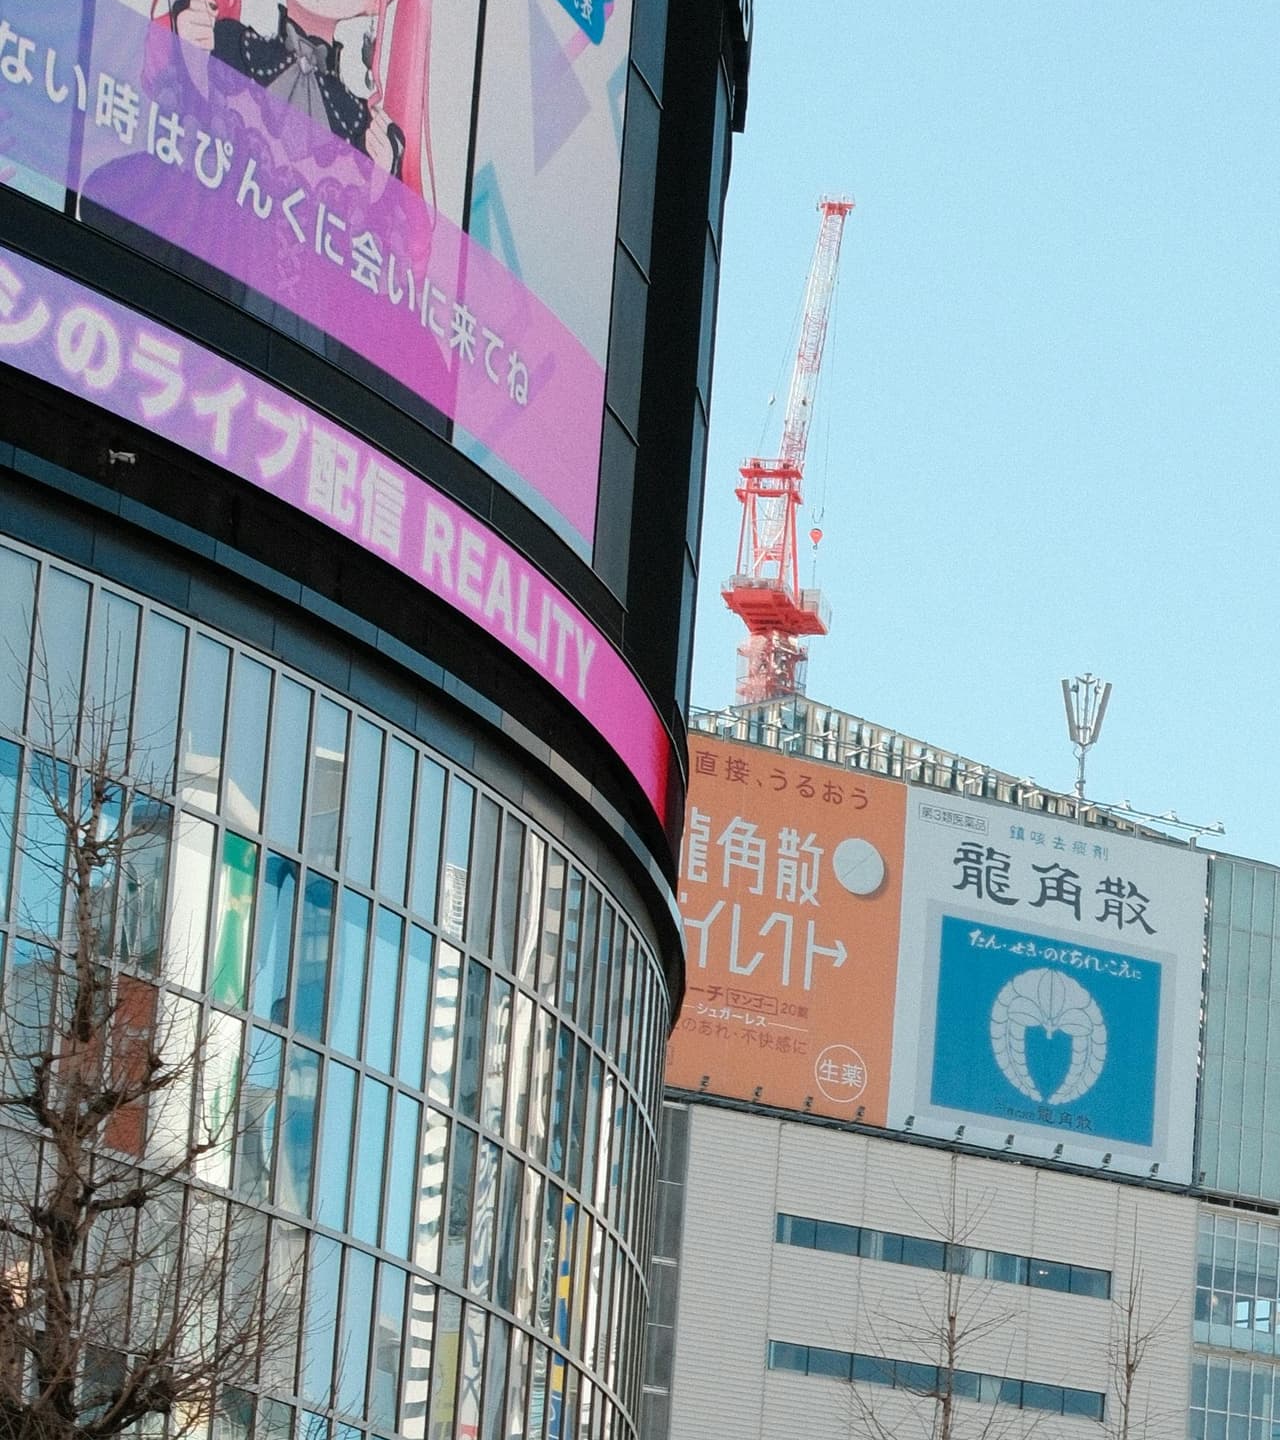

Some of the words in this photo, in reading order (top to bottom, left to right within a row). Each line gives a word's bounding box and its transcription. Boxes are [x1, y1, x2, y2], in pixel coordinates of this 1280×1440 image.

[421, 500, 597, 701] REALITY
[695, 749, 870, 811] 直接、うるおう
[952, 840, 1158, 936] 龍角散
[683, 892, 849, 992] イレクト
[696, 1002, 768, 1028] シュガーレス
[730, 989, 776, 1012] マンゴー
[818, 1059, 864, 1088] 生薬
